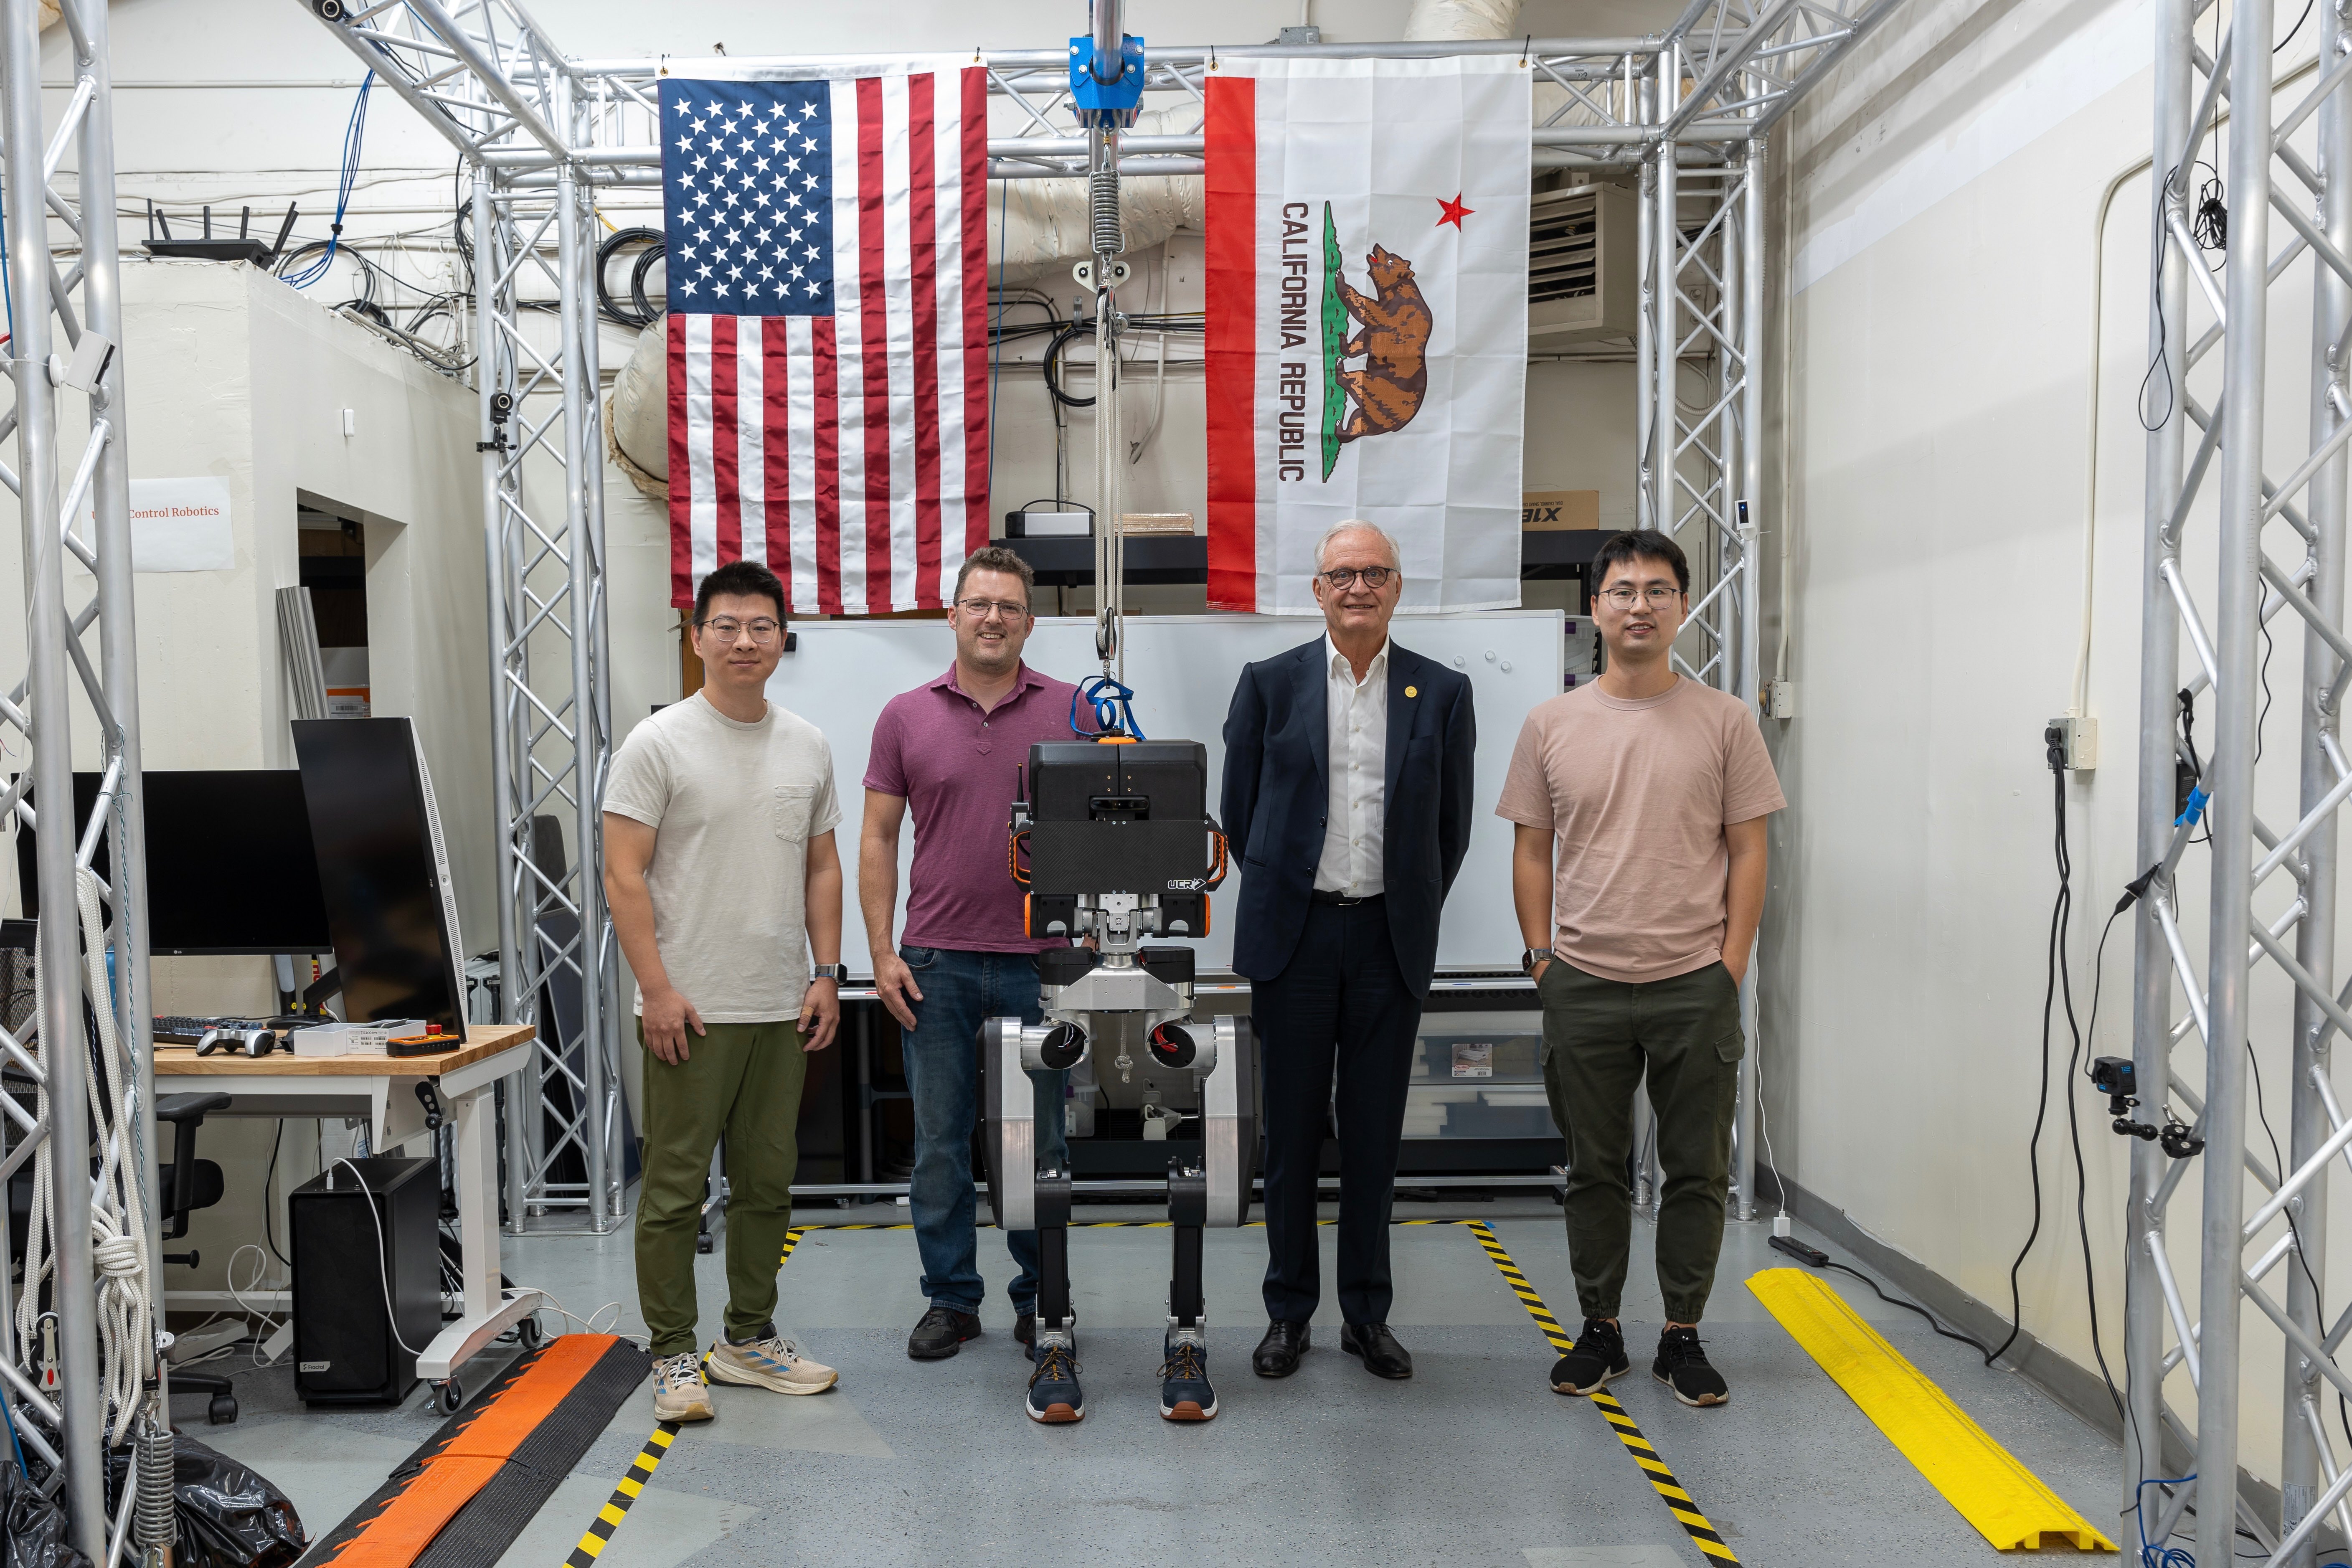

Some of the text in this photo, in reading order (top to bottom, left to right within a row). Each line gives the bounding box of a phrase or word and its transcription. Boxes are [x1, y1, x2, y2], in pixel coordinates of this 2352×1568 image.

[1279, 202, 1308, 482] CALIFORNIA REPUBLIC
[172, 506, 219, 517] Robotics
[1168, 880, 1192, 889] UCR
